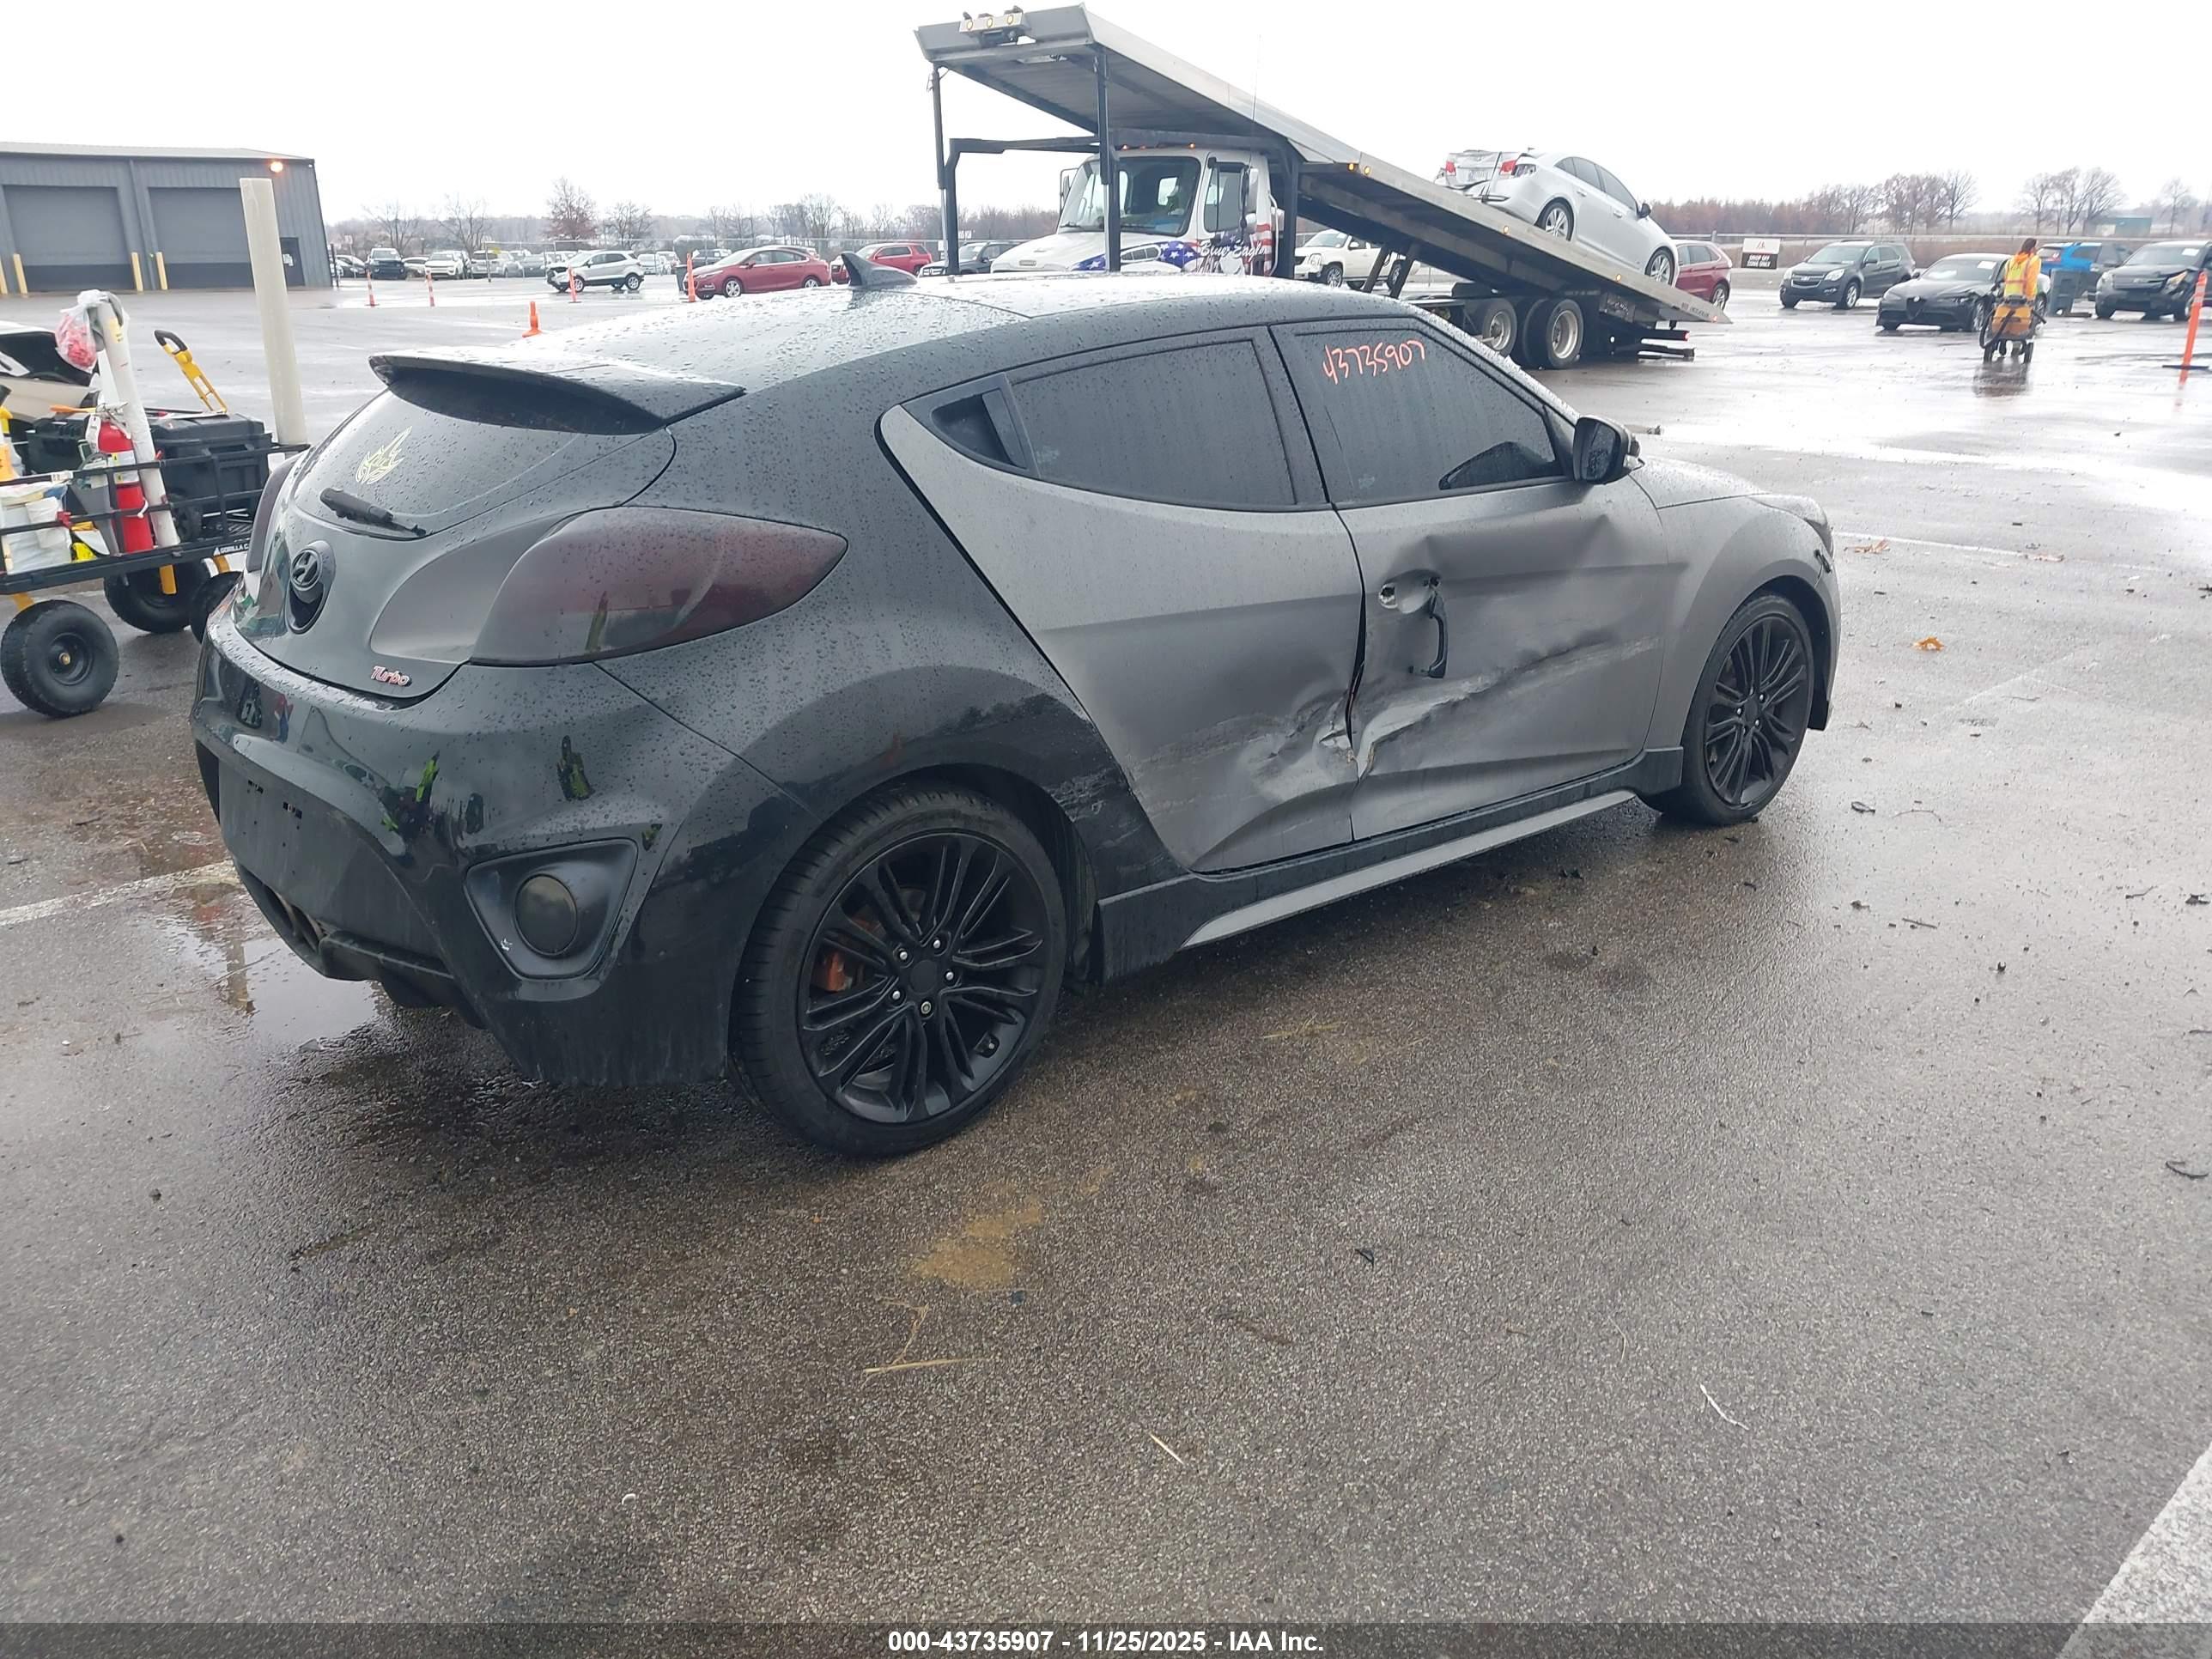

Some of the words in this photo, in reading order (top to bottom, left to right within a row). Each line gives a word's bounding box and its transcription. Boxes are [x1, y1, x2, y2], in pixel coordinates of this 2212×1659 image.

[1200, 239, 1229, 258] Blue
[1322, 340, 1425, 385] 43735907
[370, 665, 410, 686] Turbo
